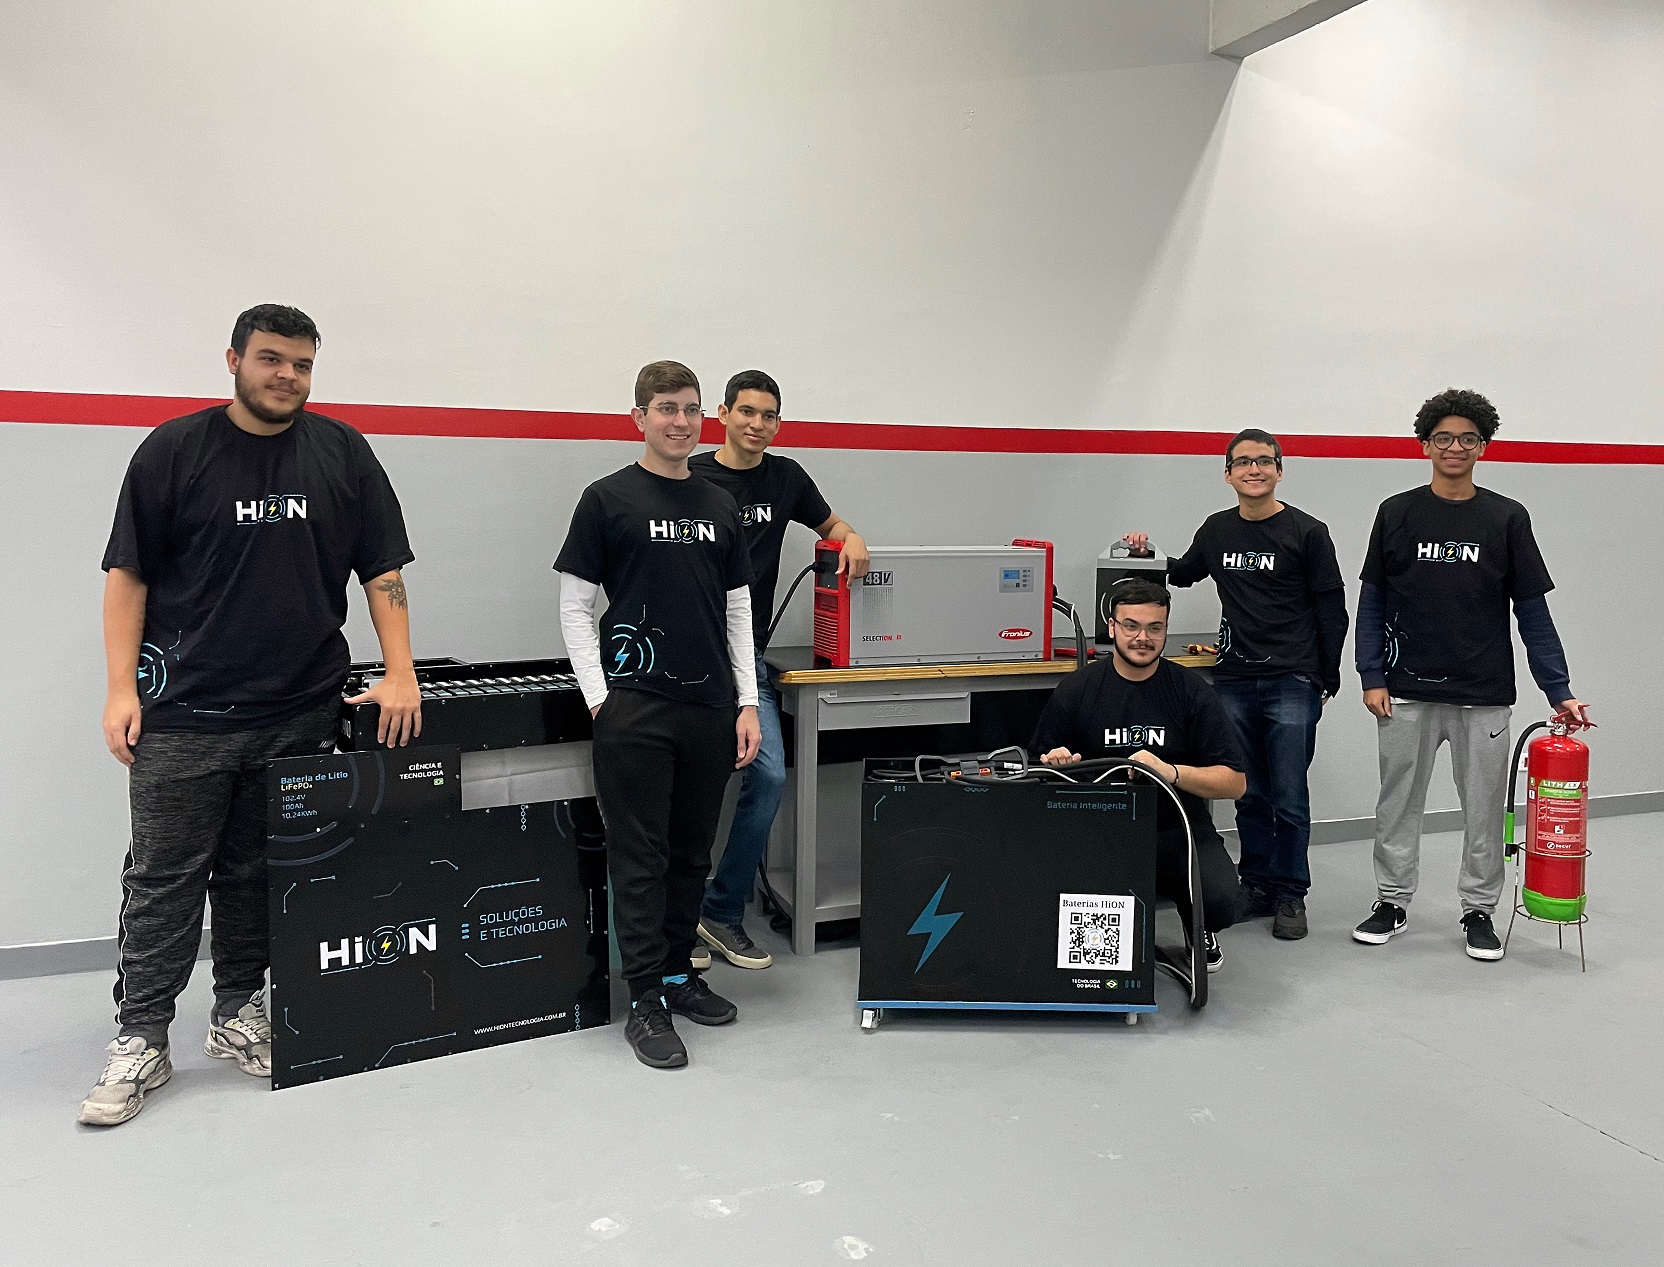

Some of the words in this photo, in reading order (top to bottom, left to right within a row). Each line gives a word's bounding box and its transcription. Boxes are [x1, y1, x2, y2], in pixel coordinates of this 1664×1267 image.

[739, 503, 772, 526] ON
[649, 519, 716, 543] HiON
[1001, 630, 1031, 638] Fronius
[1105, 725, 1165, 747] HiON
[399, 770, 444, 780] TECNOLOGIA
[408, 763, 437, 771] CIÊNCIA
[280, 775, 313, 785] Bateria
[315, 773, 327, 781] de
[1046, 801, 1078, 809] Bateria
[1062, 899, 1099, 908] Baterias
[1101, 900, 1125, 909] HiON
[479, 905, 543, 925] SOLUÇÕES
[480, 929, 488, 941] E
[490, 917, 568, 939] TECNOLOGIA
[319, 917, 437, 975] HiON
